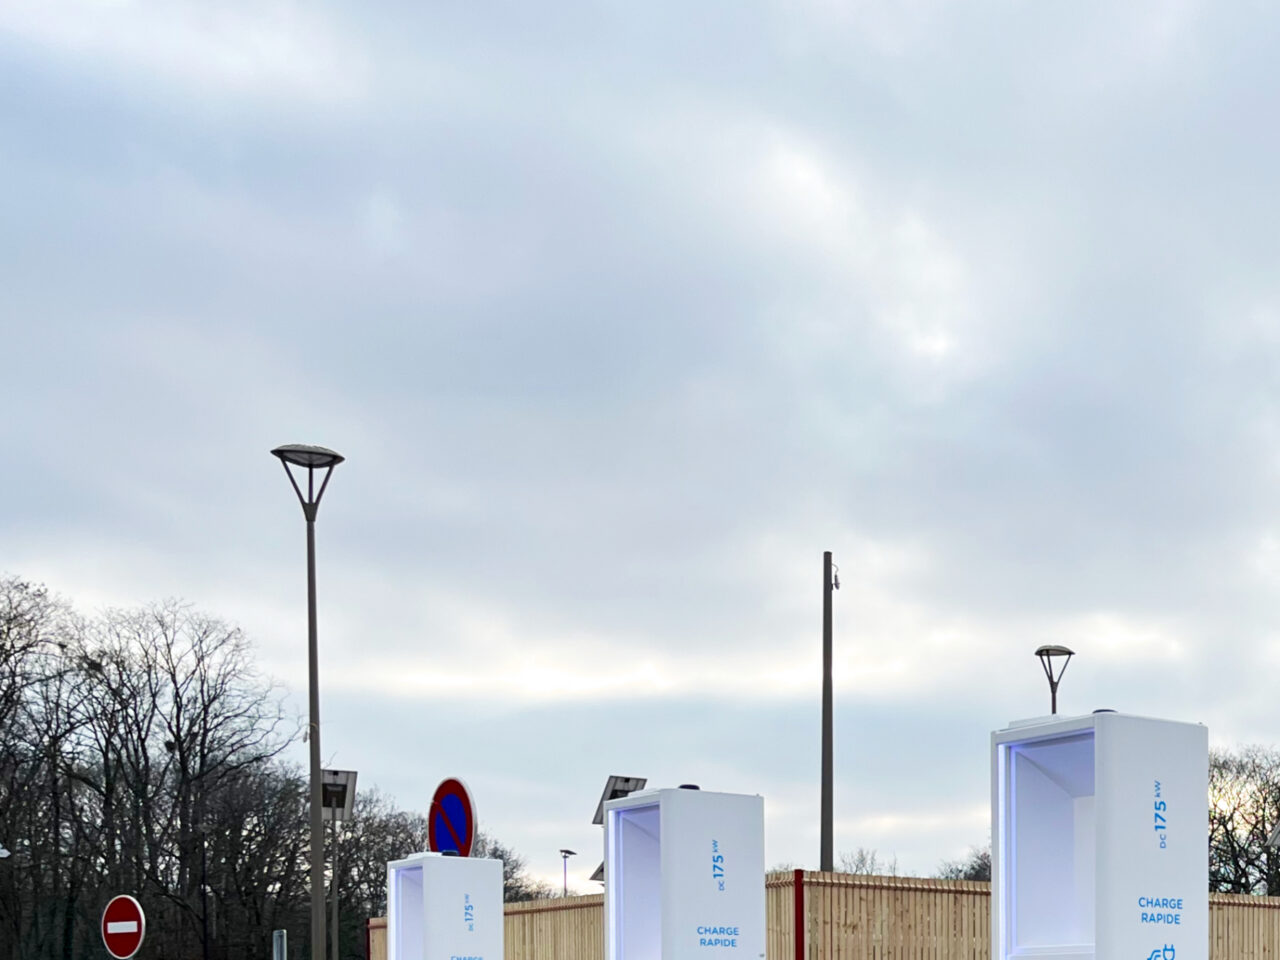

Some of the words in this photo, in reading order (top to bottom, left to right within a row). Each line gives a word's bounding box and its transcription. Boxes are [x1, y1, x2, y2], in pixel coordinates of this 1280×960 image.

[1154, 800, 1167, 832] 175
[712, 855, 724, 879] 175
[1138, 897, 1183, 909] CHARGE
[464, 905, 474, 922] 175
[1140, 912, 1181, 925] RAPIDE
[697, 926, 740, 936] CHARGE
[700, 938, 737, 948] RAPIDE
